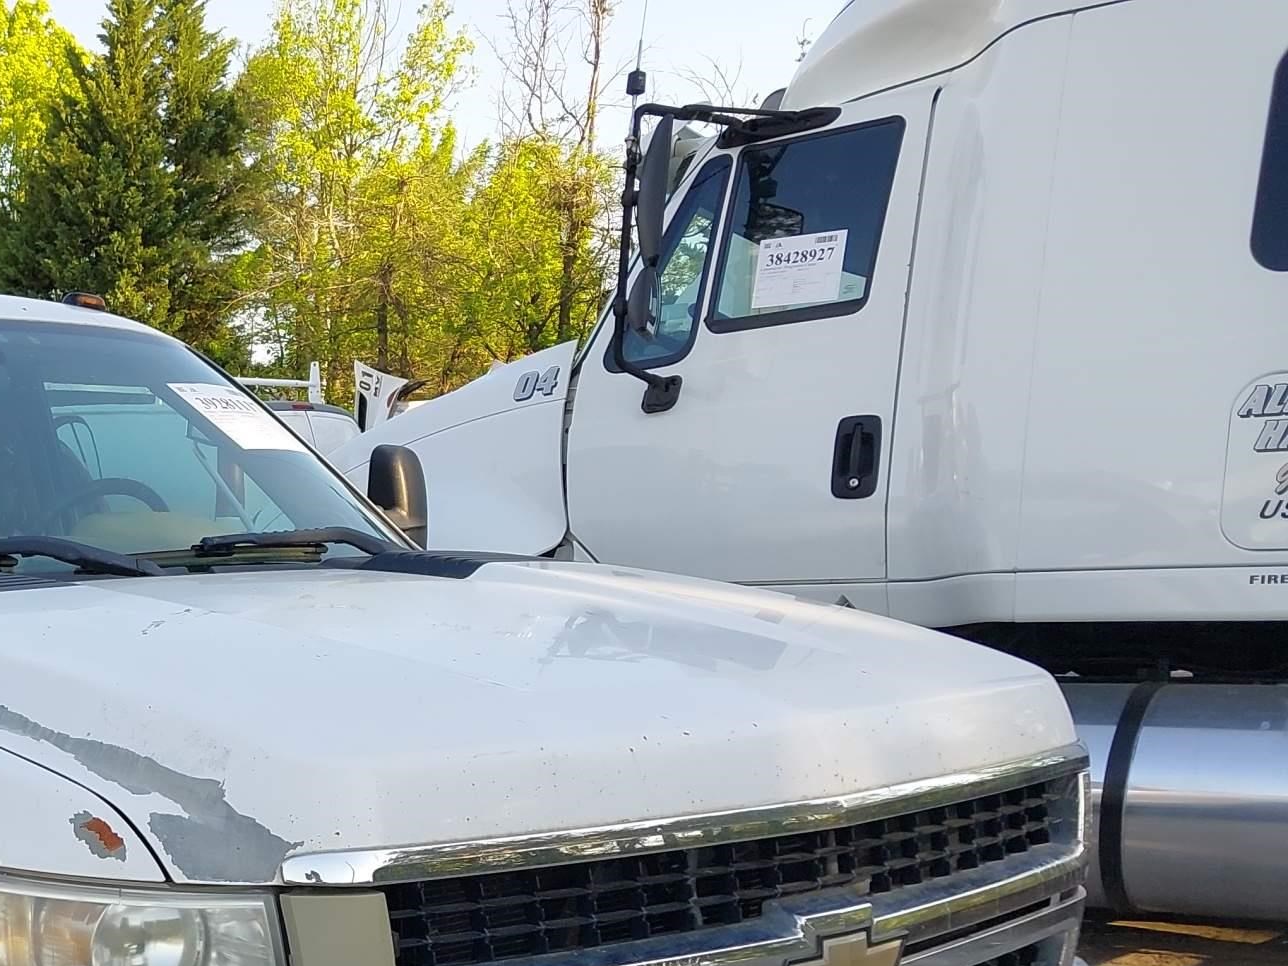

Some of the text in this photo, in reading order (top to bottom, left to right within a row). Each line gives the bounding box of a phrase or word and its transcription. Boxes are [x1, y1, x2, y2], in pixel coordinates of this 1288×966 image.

[766, 247, 835, 267] 38428927
[513, 366, 560, 402] 04
[1237, 383, 1288, 418] AL
